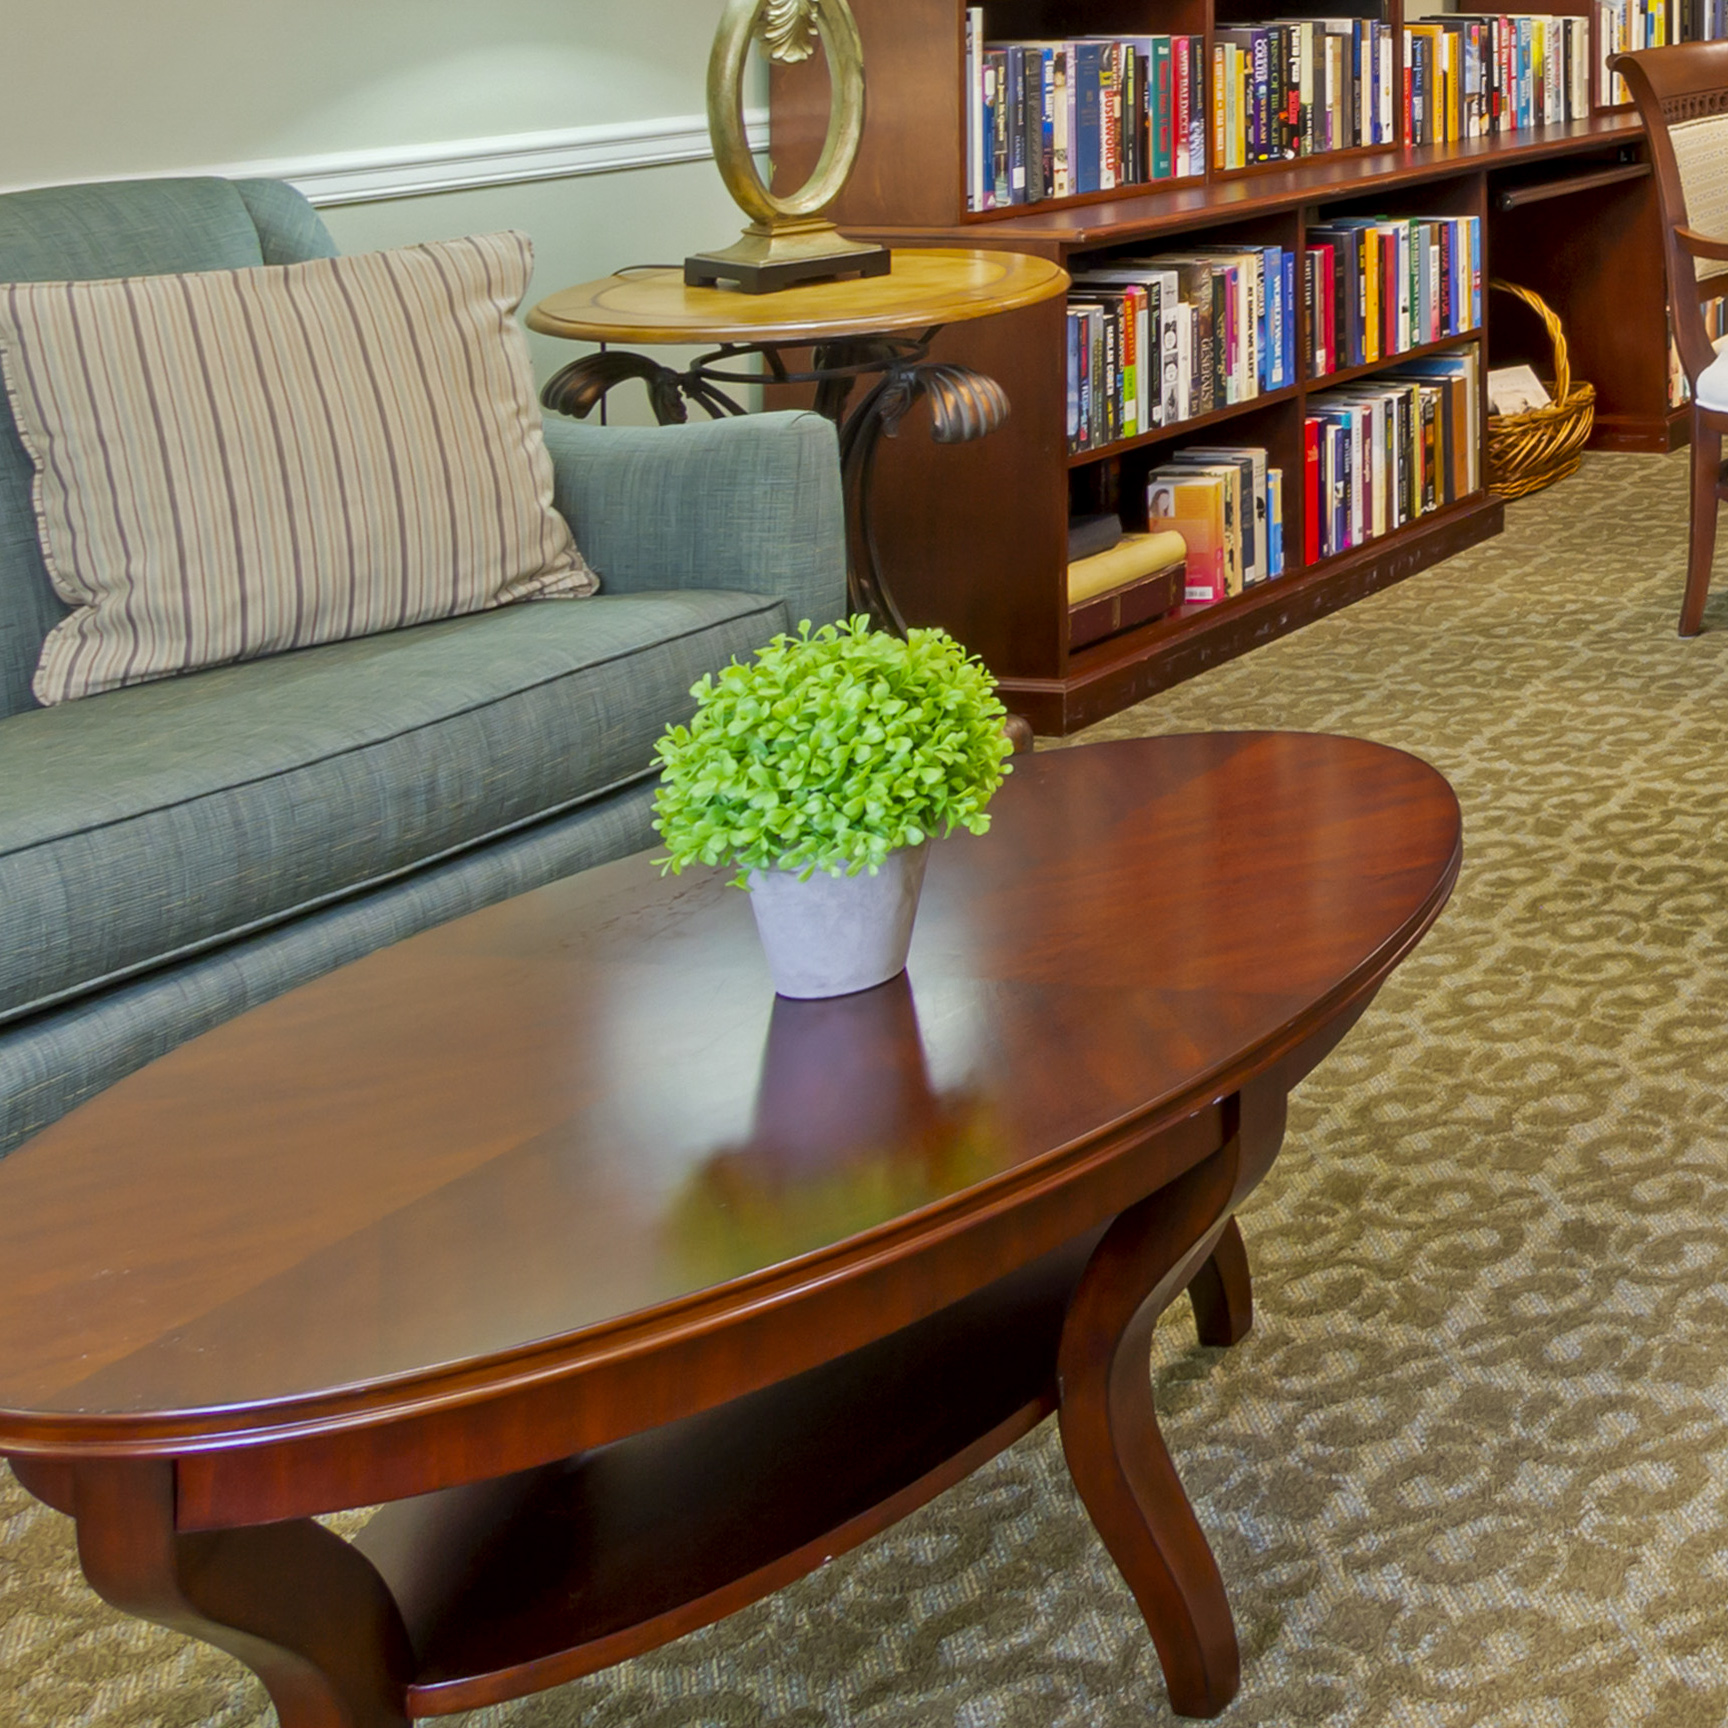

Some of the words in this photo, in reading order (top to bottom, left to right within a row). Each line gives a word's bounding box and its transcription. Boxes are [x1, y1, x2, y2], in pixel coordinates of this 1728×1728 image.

[1270, 40, 1279, 70] KING
[1270, 73, 1279, 89] OF
[1041, 86, 1055, 122] Clancy
[1179, 78, 1189, 135] BALDACCI
[1104, 90, 1115, 171] BUSHWORLD
[1270, 114, 1279, 146] NIGHT
[1247, 299, 1255, 330] DAWN
[1274, 275, 1282, 322] WORLD
[1106, 325, 1114, 363] HARLAN
[1125, 300, 1135, 361] AMBERVILLE
[1247, 331, 1255, 348] WE
[1274, 324, 1282, 357] WAR
[1106, 363, 1114, 396] COBEN
[1247, 351, 1255, 380] SLEPT
